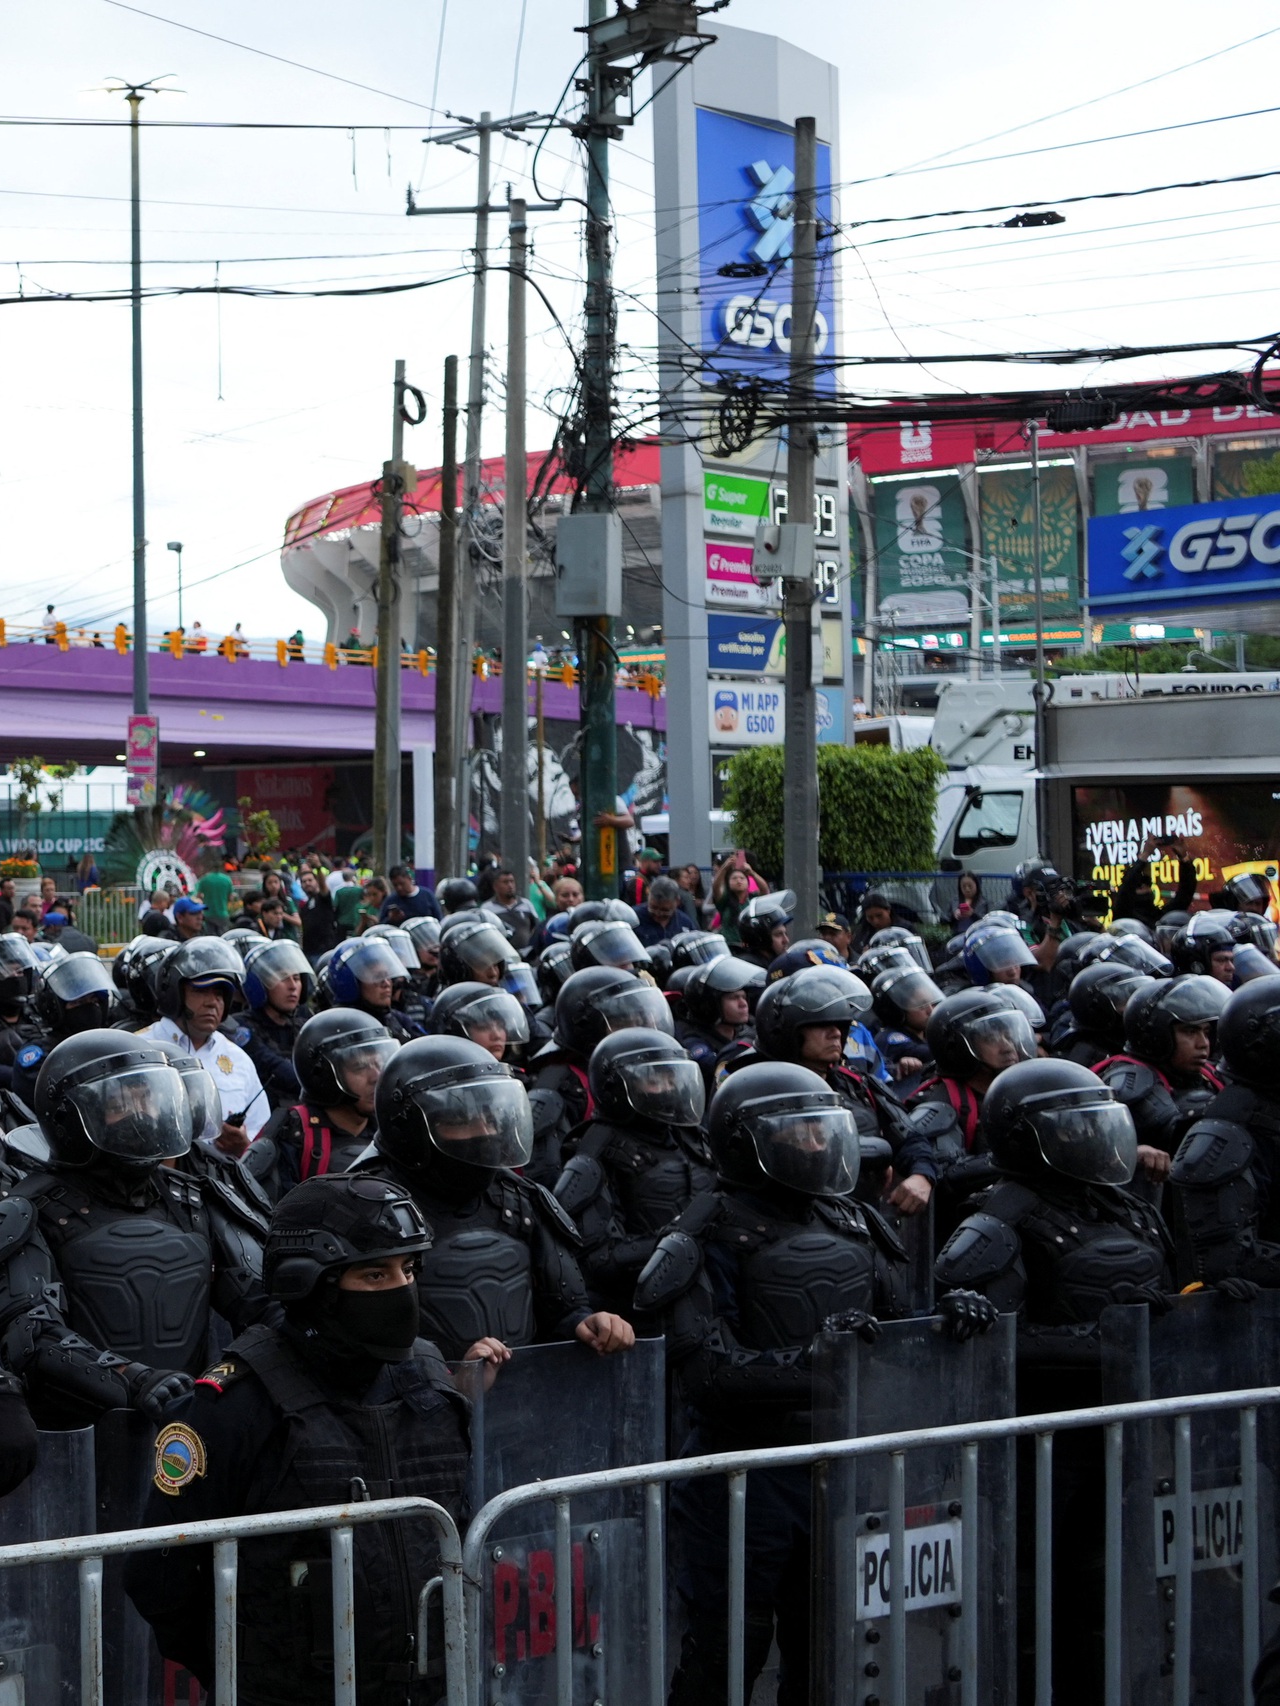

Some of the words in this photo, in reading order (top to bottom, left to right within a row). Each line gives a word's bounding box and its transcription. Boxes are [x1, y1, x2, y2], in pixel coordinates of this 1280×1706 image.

[720, 558, 751, 575] Premiu
[899, 553, 945, 568] COPA
[711, 584, 748, 598] Premium
[742, 692, 754, 711] MI
[757, 693, 779, 712] APP
[746, 715, 775, 734] G500
[1086, 820, 1125, 851] ¡VEN
[1127, 819, 1140, 842] A
[1141, 816, 1162, 841] MI
[1166, 807, 1203, 838] PAÍS
[56, 838, 83, 853] CUP
[1091, 844, 1104, 866] Y
[1150, 855, 1215, 884] FÚTOL
[1162, 1499, 1243, 1566] PLICIA
[864, 1538, 956, 1607] POICIA
